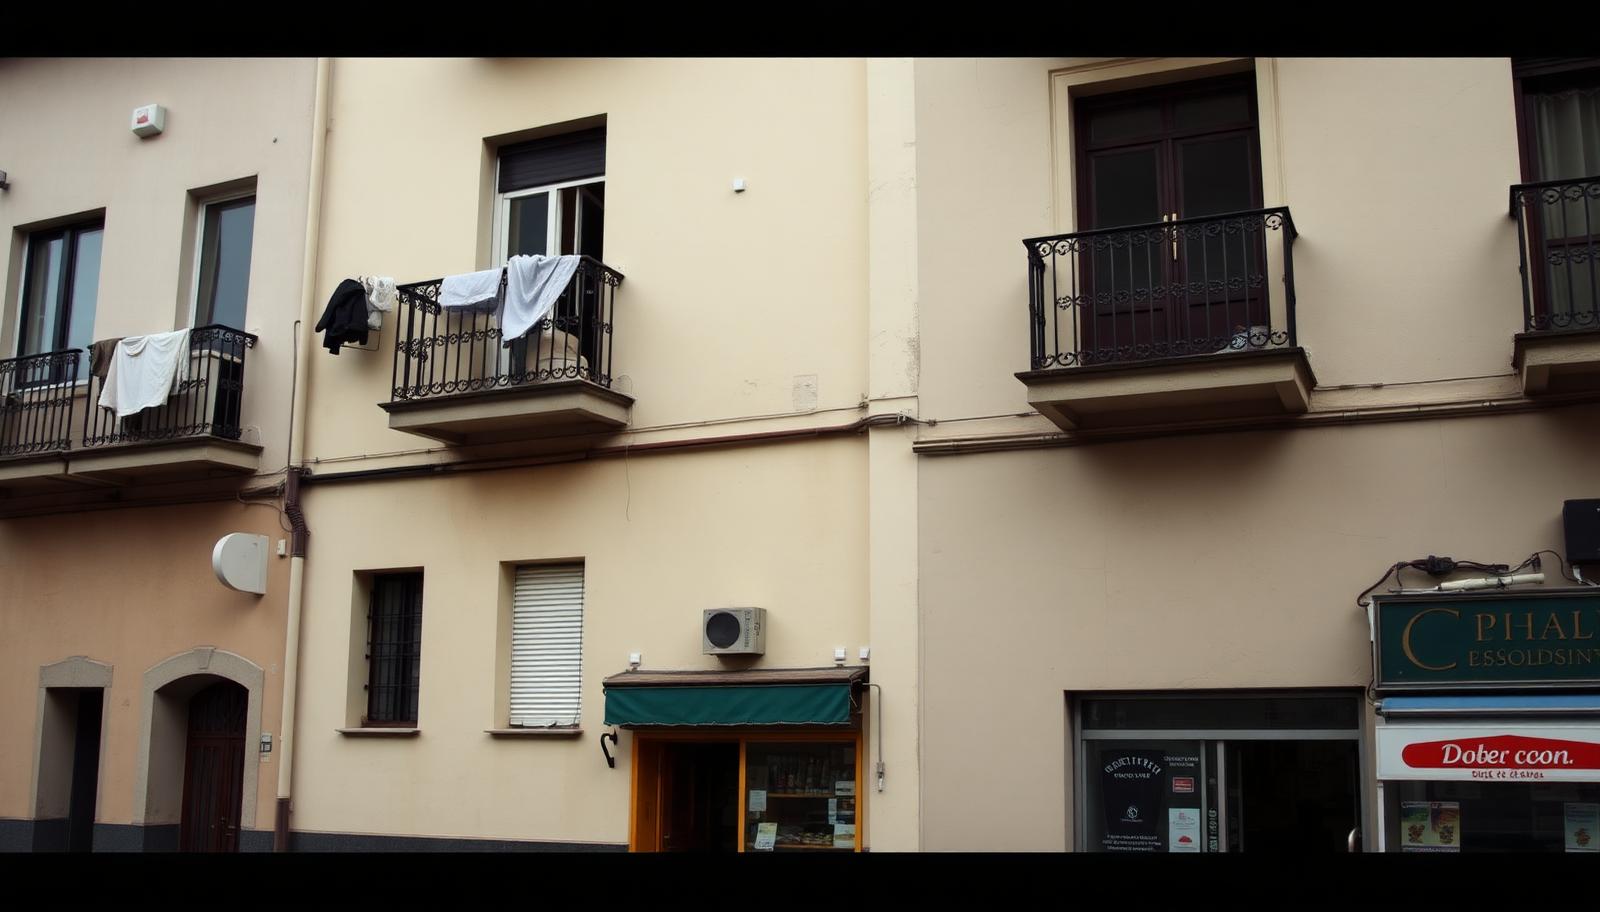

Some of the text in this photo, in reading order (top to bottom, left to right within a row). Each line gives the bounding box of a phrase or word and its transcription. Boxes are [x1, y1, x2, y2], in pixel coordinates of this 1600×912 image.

[1402, 607, 1600, 671] C PHAL
[1441, 743, 1510, 765] Dober
